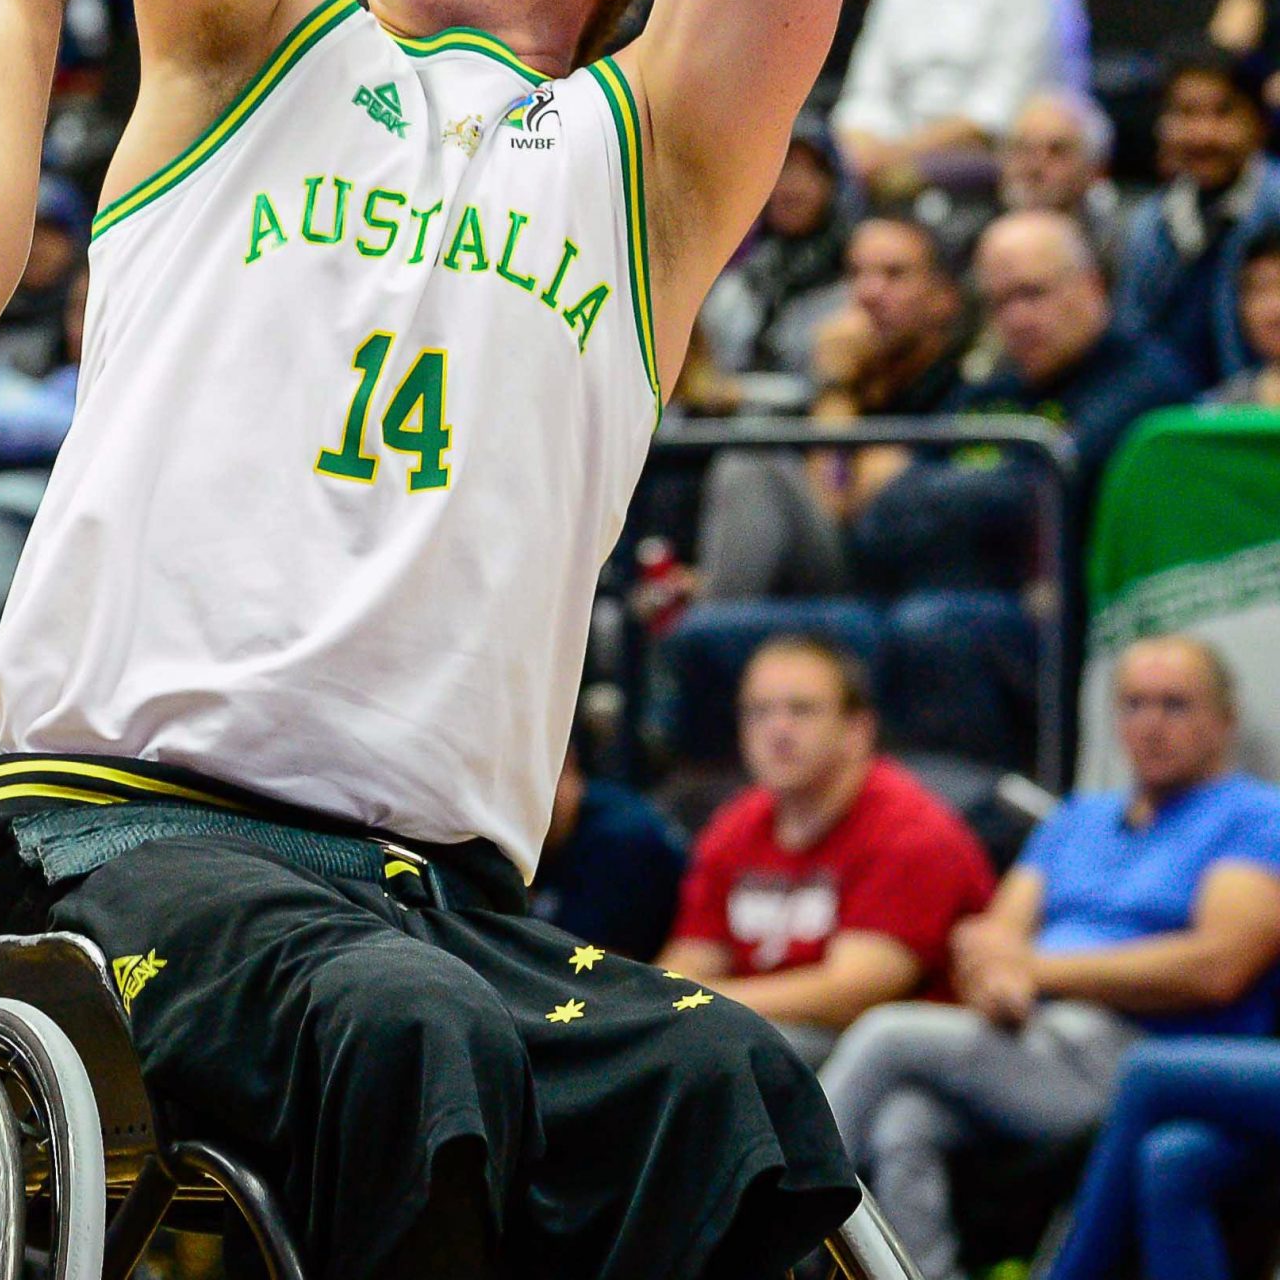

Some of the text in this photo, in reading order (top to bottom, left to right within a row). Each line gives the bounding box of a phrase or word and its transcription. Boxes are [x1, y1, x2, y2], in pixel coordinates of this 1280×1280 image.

[351, 84, 411, 139] PEAK
[510, 138, 556, 150] IWBF
[244, 175, 612, 354] AUSTALIA
[313, 329, 453, 494] 14
